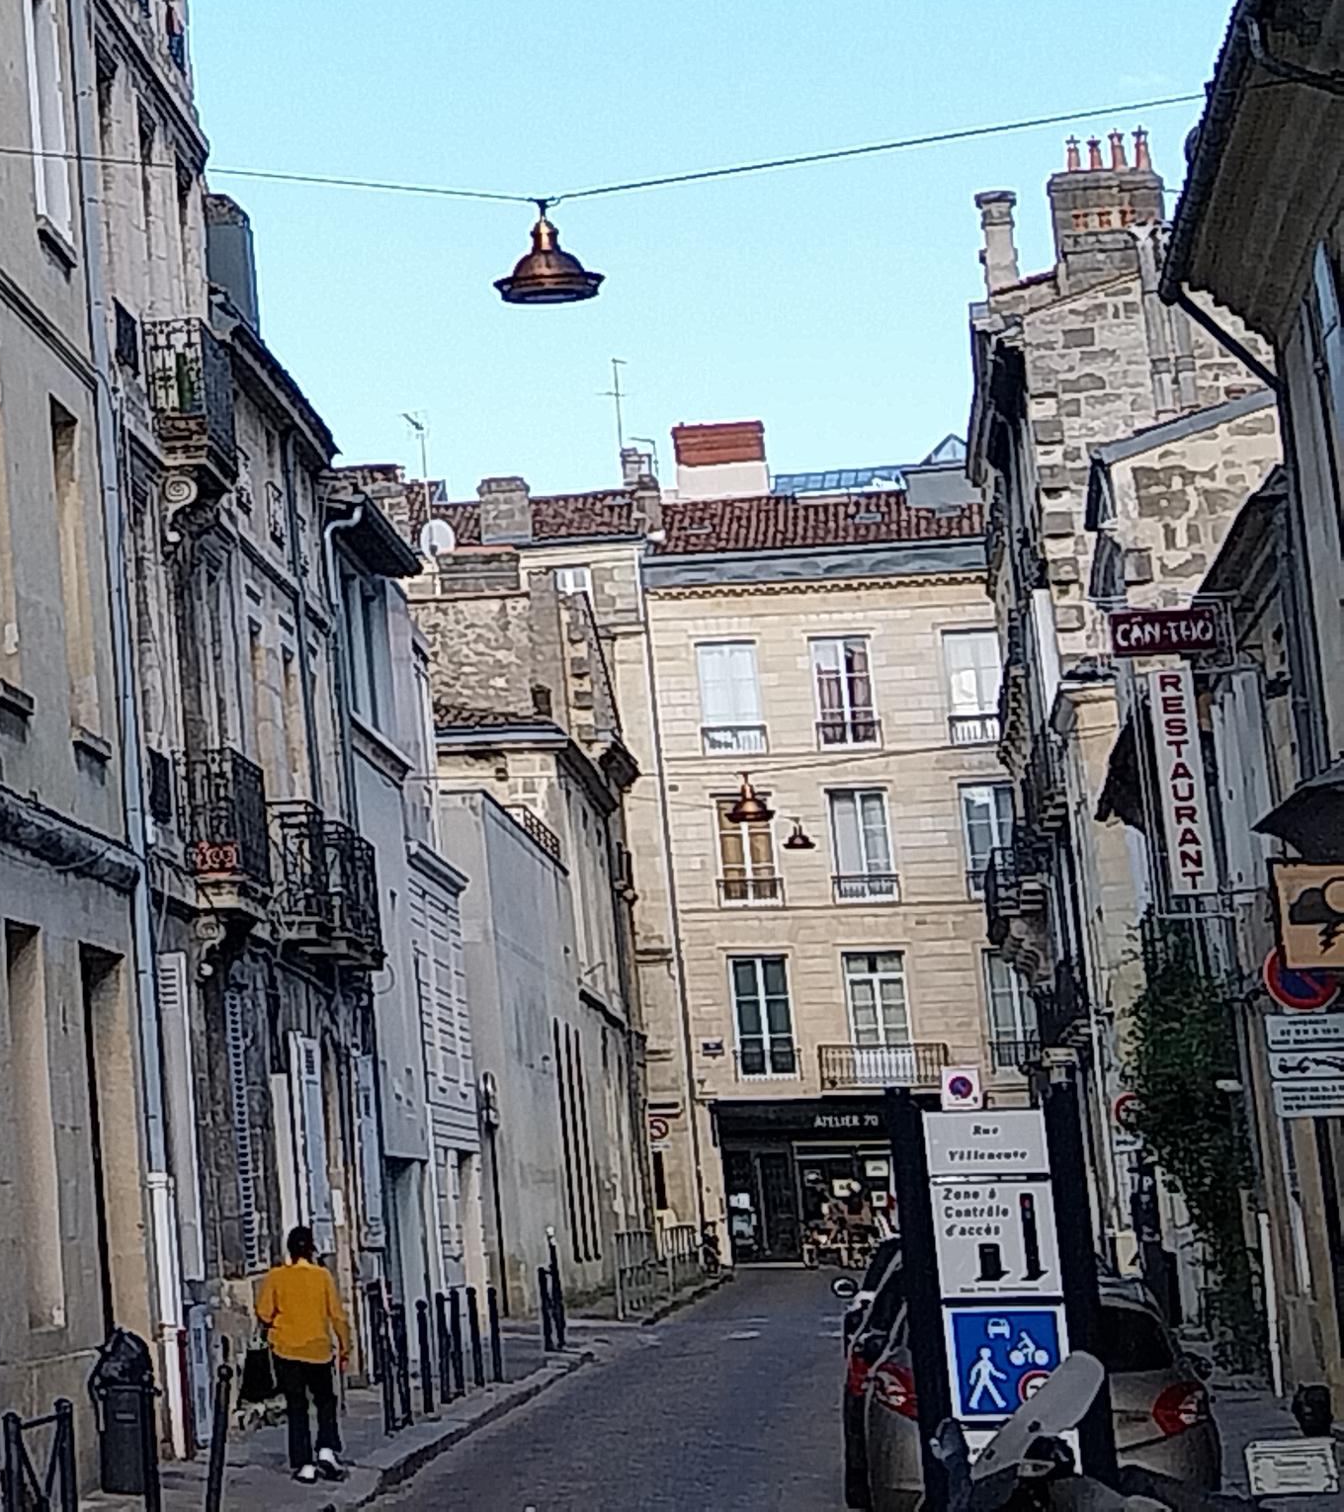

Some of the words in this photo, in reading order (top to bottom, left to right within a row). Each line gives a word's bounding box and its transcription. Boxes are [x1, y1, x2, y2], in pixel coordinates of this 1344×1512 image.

[1159, 672, 1206, 890] RESTAURANT
[972, 1125, 999, 1136] Rue
[942, 1187, 980, 1201] Zone
[944, 1205, 1010, 1219] Contrôle
[945, 1224, 1001, 1237] d'accès
